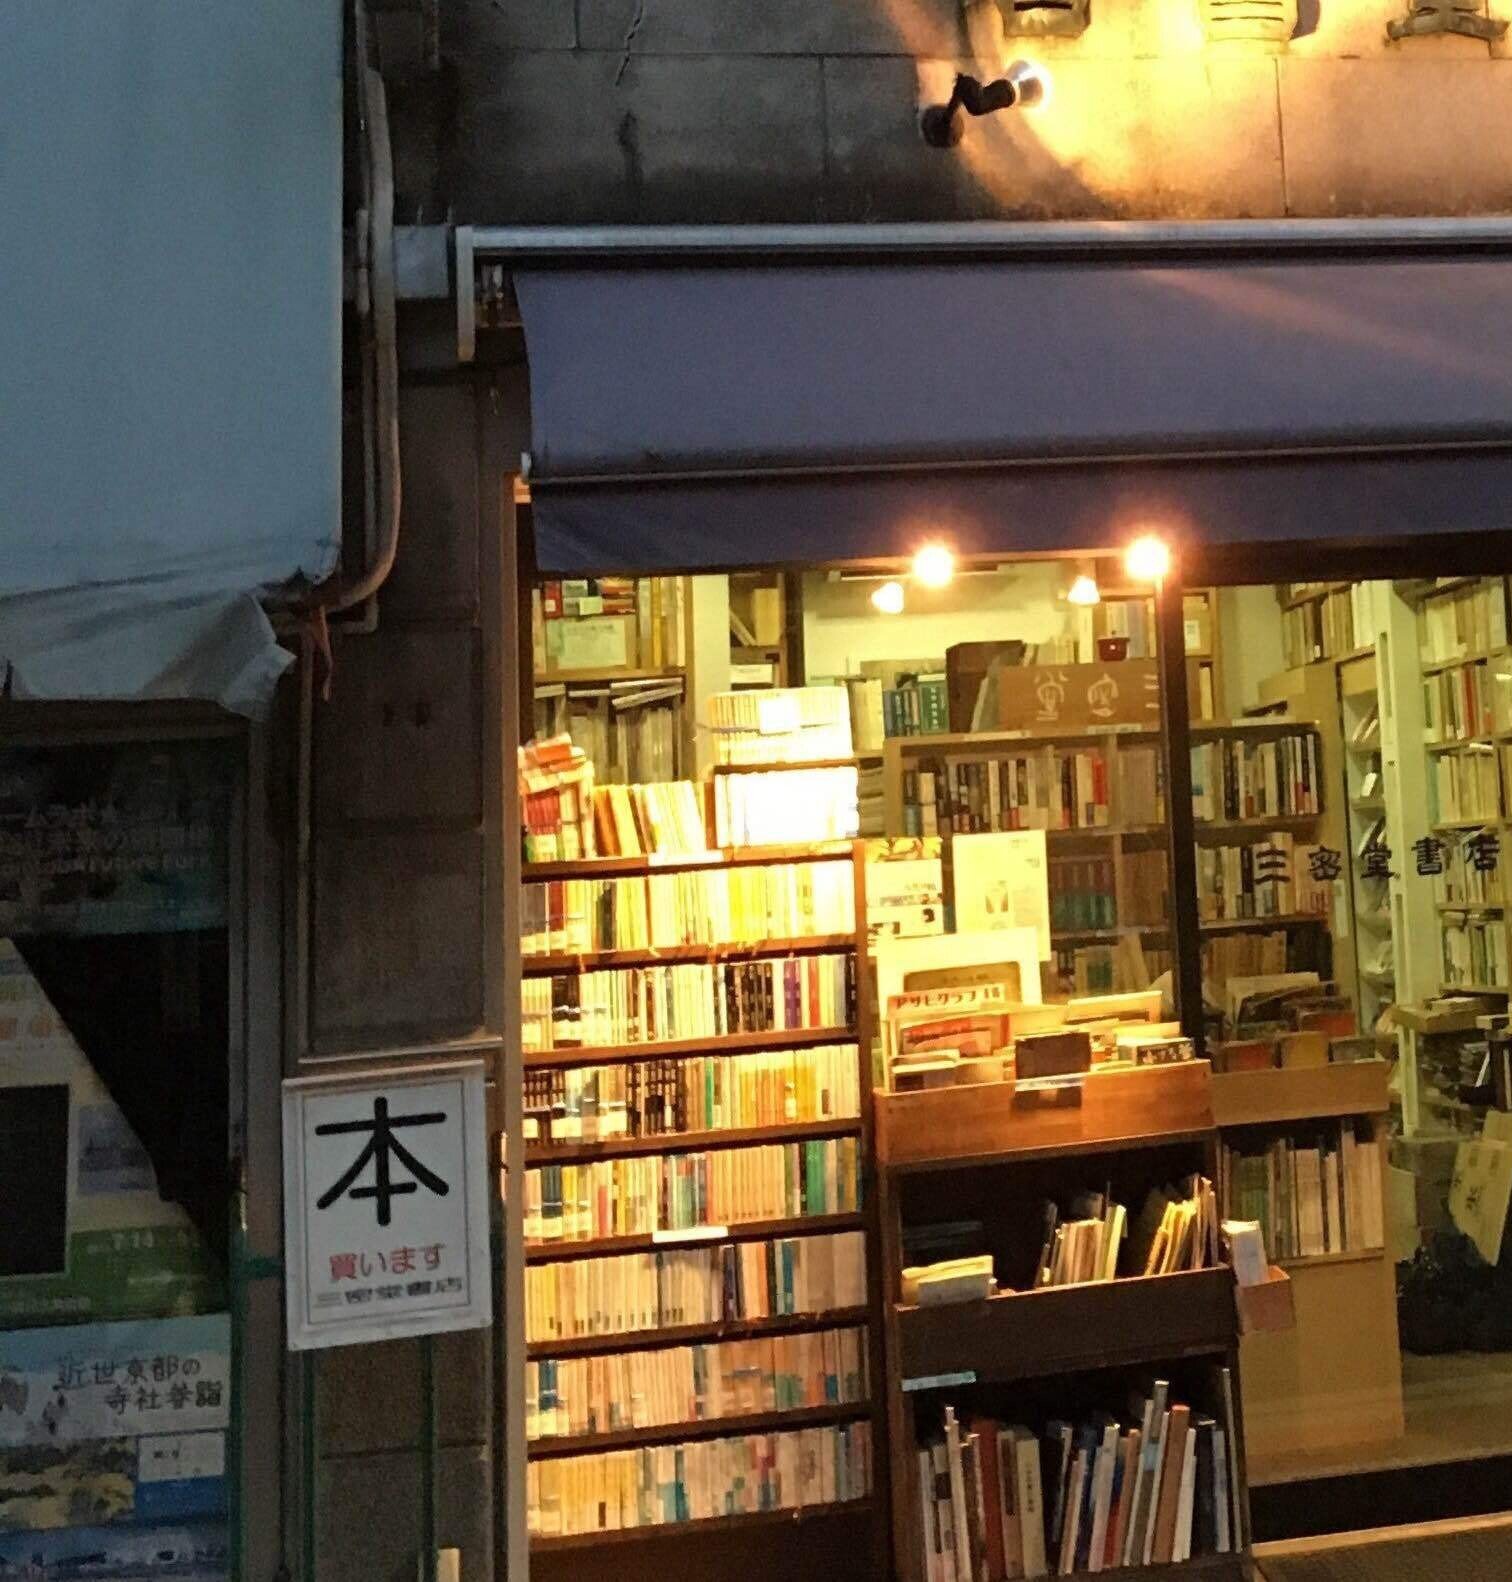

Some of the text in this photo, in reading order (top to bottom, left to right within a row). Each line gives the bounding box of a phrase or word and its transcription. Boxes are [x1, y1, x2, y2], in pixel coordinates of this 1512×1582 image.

[1254, 833, 1501, 884] 三密堂書店
[314, 1096, 450, 1227] 本
[329, 1243, 448, 1281] 買います
